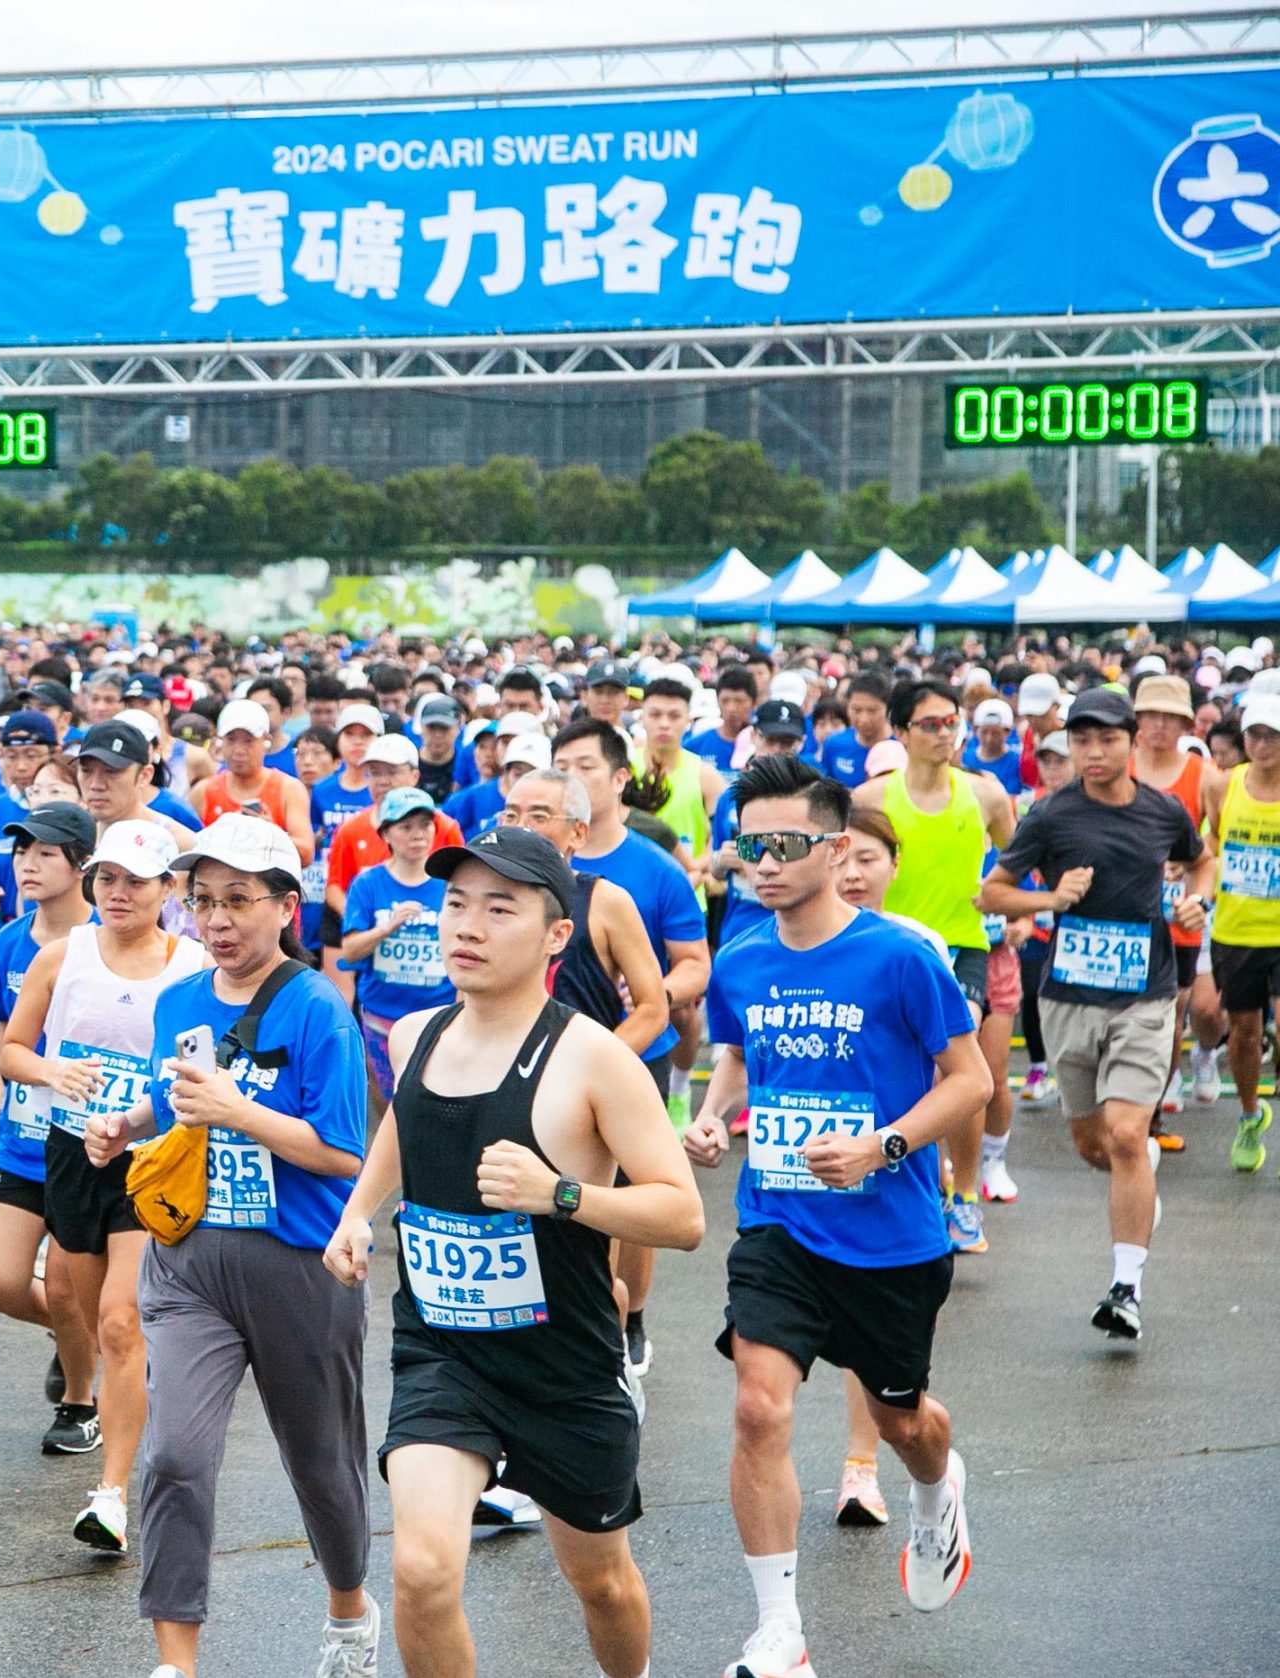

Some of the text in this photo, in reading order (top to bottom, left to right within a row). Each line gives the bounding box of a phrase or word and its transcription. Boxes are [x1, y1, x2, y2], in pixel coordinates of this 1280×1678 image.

[273, 130, 697, 174] 2024 POCARI SWEAT RUN
[173, 175, 802, 313] 寶礦力路跑
[955, 381, 1197, 443] 00:00:08
[1063, 933, 1142, 959] 51248
[244, 1192, 268, 1203] 157
[774, 1177, 793, 1186] 10K
[408, 1232, 527, 1281] 51925
[432, 1311, 453, 1323] 10K
